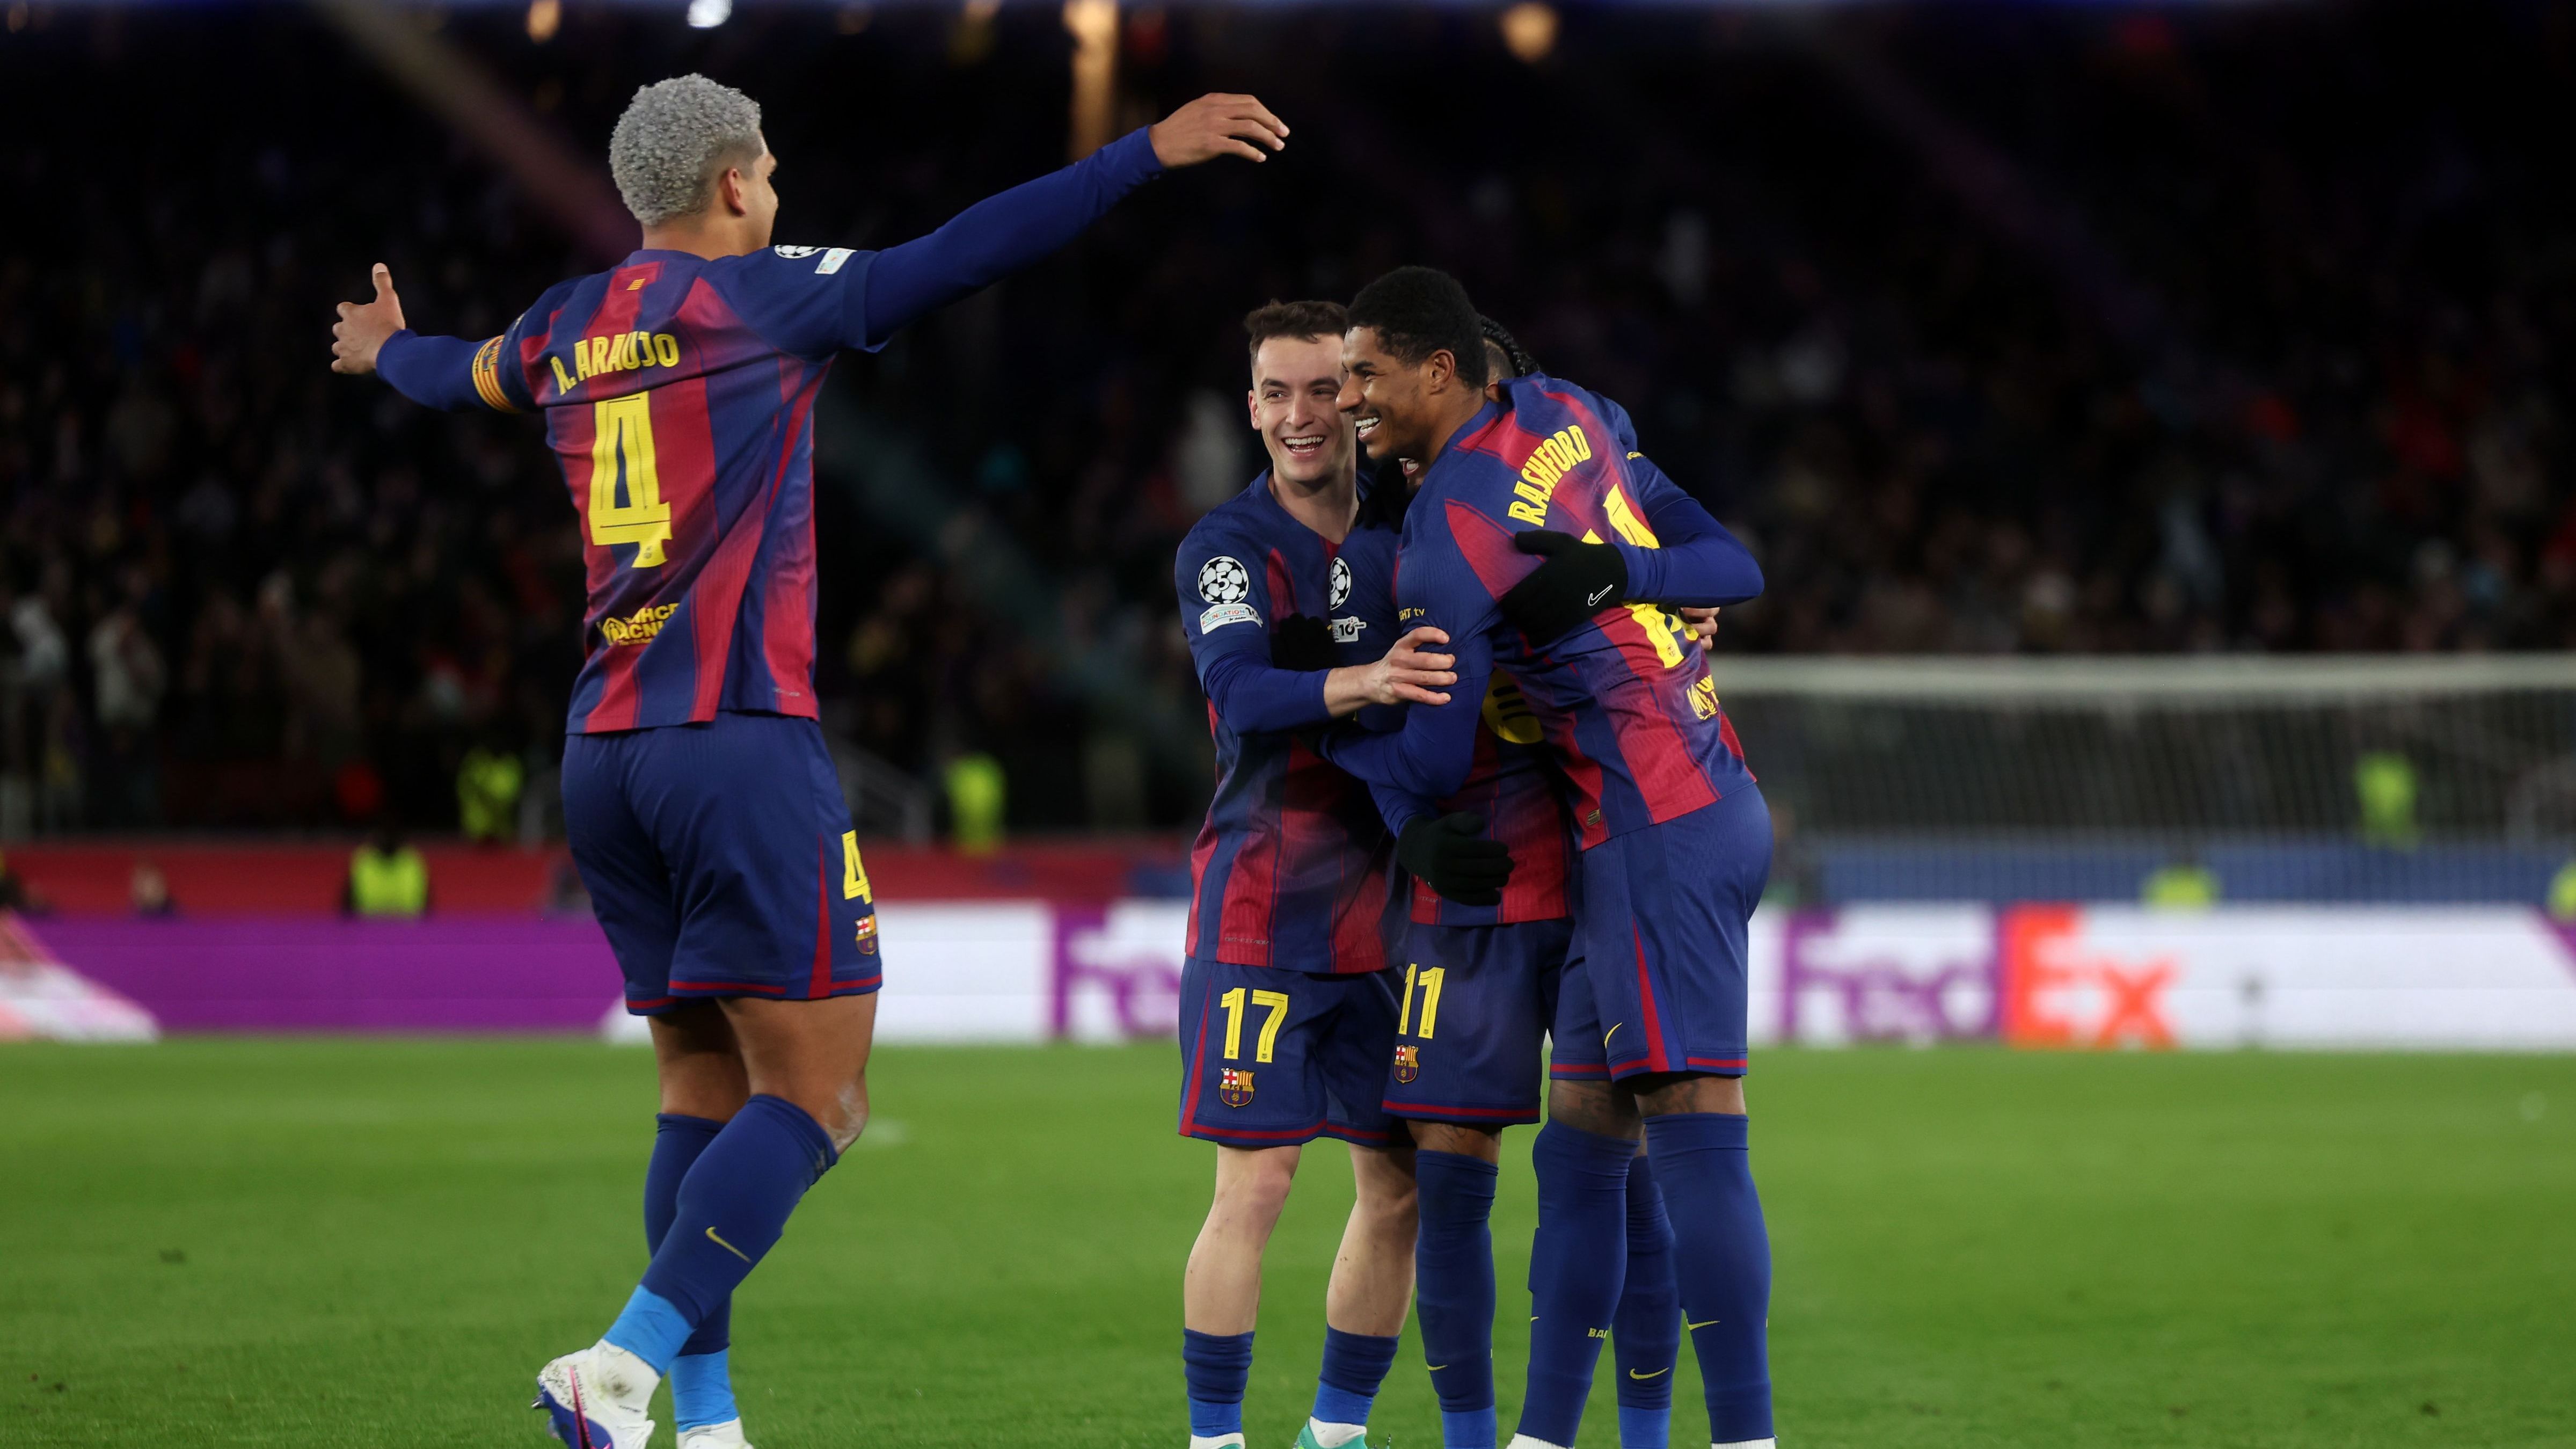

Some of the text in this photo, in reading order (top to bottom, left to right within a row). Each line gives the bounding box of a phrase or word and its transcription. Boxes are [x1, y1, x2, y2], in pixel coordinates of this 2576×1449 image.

[574, 331, 679, 382] ARAUJO
[588, 390, 673, 568] 4
[1507, 425, 1592, 527] RASHFORD
[1201, 609, 1245, 627] FOUNDATION
[1216, 571, 1230, 591] 5
[1413, 607, 1425, 617] tv
[1338, 624, 1355, 636] 10
[841, 829, 872, 905] 4
[1398, 963, 1445, 1039] 11
[1781, 902, 2179, 1048] FedEx
[1220, 987, 1288, 1063] 17
